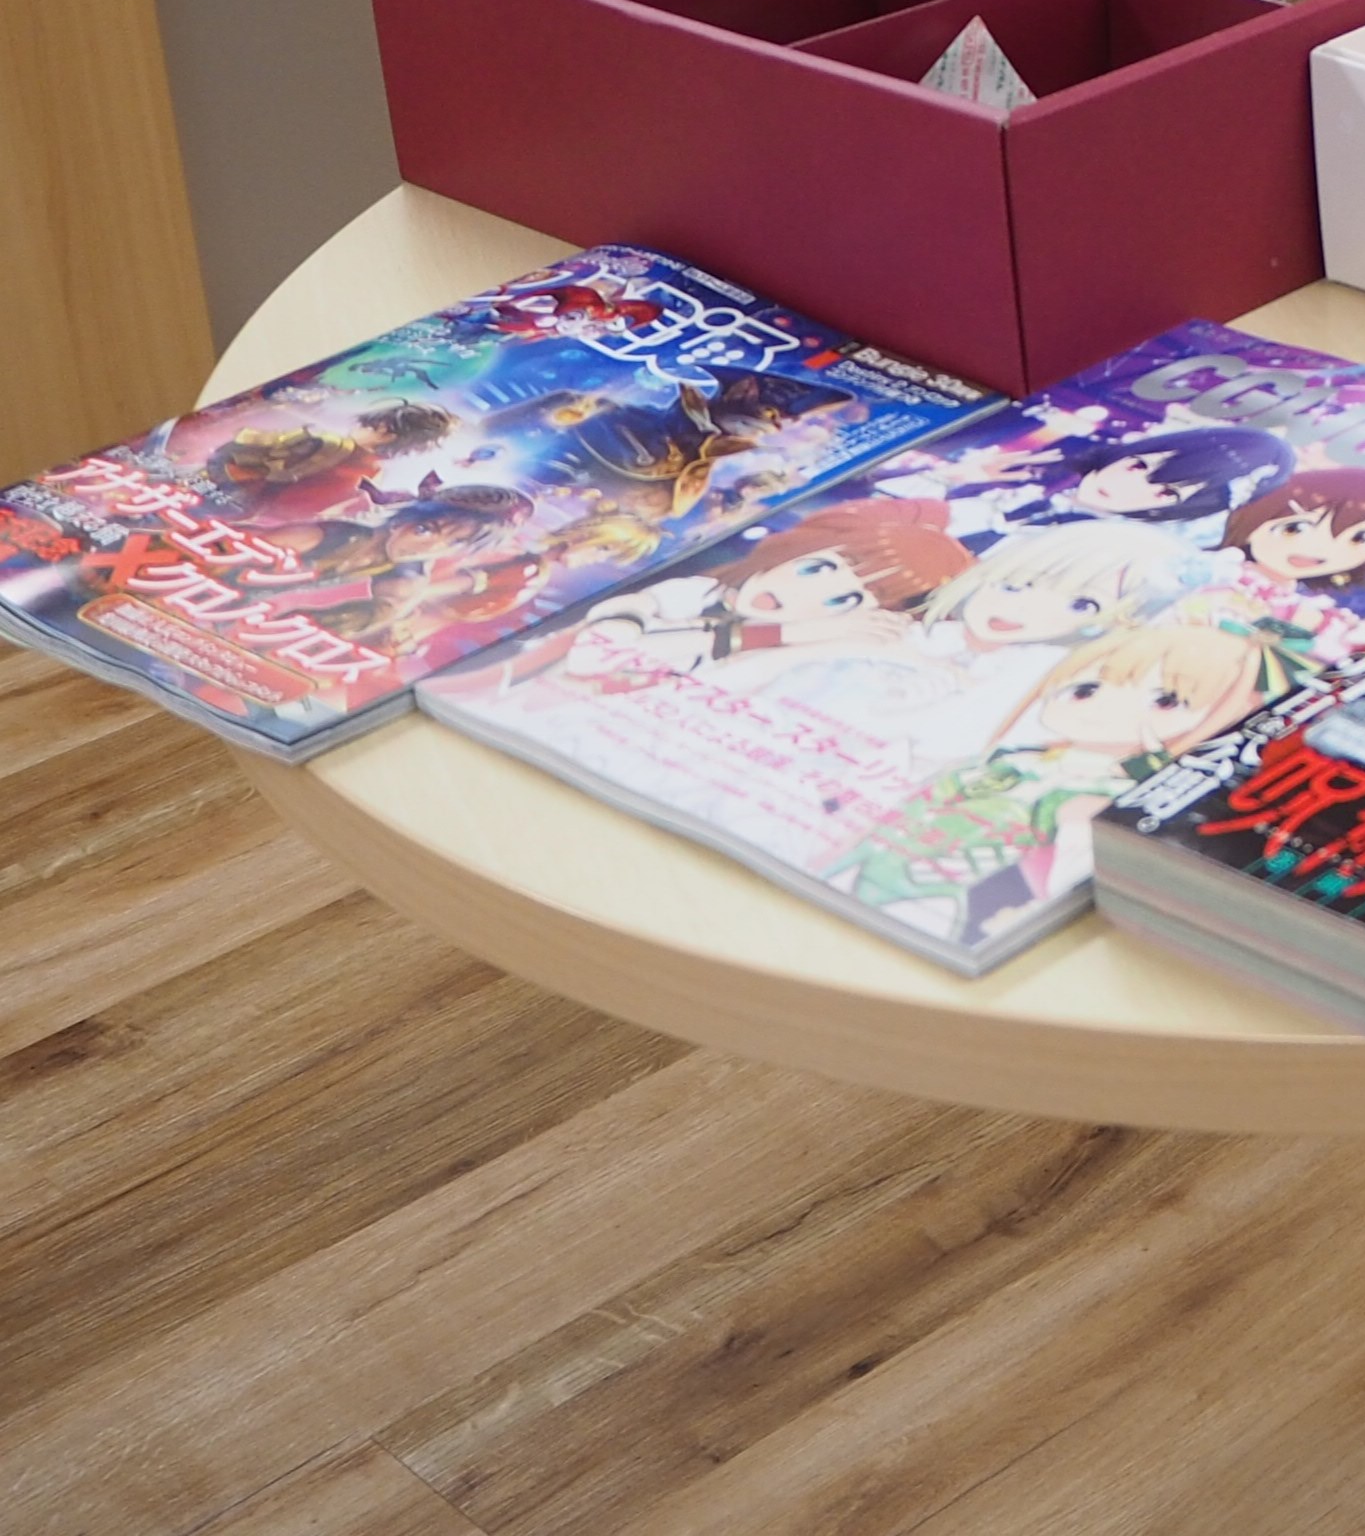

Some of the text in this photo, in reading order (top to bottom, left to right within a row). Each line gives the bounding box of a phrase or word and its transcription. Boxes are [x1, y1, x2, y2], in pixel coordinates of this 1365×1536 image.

[45, 456, 324, 594] アナザーエデン
[129, 550, 392, 688] クロノ・クロス
